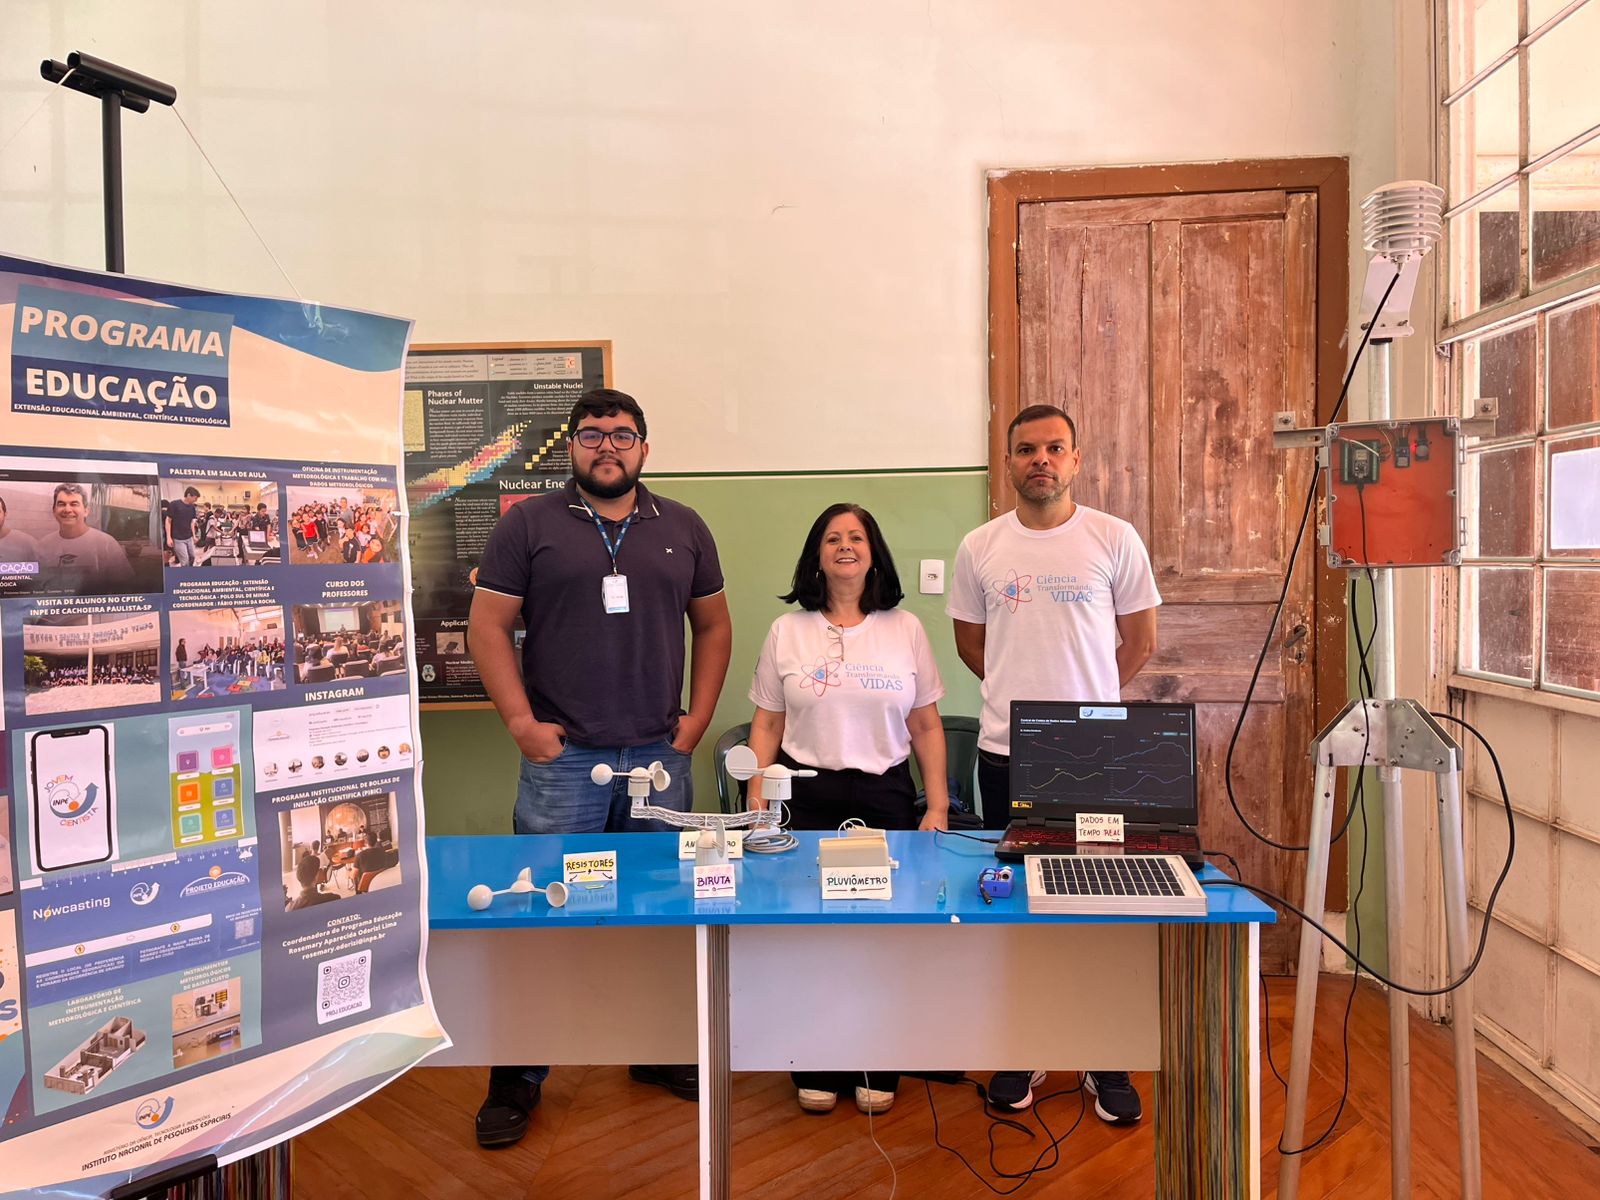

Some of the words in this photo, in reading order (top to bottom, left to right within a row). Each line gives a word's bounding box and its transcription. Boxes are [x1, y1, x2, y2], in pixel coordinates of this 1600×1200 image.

[20, 306, 224, 357] PROGRAMA
[27, 368, 217, 413] EDUCAÇÃO
[14, 404, 50, 412] EXTENSÃO
[52, 406, 100, 416] EDUCACIONAL
[101, 410, 142, 419] AMBIENTAL,
[144, 414, 178, 422] CIENTÍFICA
[185, 416, 227, 425] TECNOLÓGICA
[169, 468, 206, 477] PALESTRA
[219, 470, 237, 478] SALA
[248, 471, 267, 479] AULA
[500, 480, 543, 490] Nuclear
[545, 479, 565, 489] Ene
[0, 561, 34, 574] CAÇÃO
[326, 580, 349, 588] CURSO
[350, 579, 364, 588] DOS
[1036, 575, 1077, 584] Ciência
[322, 590, 368, 598] PROFESSORES
[1051, 591, 1093, 602] VIDAS
[107, 604, 152, 612] PAULISTA-SP
[845, 663, 884, 672] Ciência
[860, 678, 903, 691] VIDAS
[305, 687, 364, 702] INSTAGRAM
[44, 774, 74, 793] JOVEM
[272, 793, 310, 804] PROGRAMA
[311, 784, 358, 797] INSTITUCIONAL
[369, 778, 391, 786] BOLSAS
[52, 797, 69, 807] INPE
[293, 798, 326, 808] INICIAÇÃO
[60, 805, 99, 826] CIENTISTA
[1080, 816, 1103, 824] DADOS
[1078, 828, 1100, 836] TEMPO
[565, 858, 614, 871] RESISTORES
[186, 883, 212, 894] PROJETO
[214, 876, 246, 888] EDUCAÇÃO
[696, 876, 730, 886] BIRUTA
[826, 874, 889, 886] PLUVIÔMETRO
[33, 897, 111, 920] Nowcasting
[327, 913, 362, 928] CONTATO:
[282, 928, 330, 947] Coordenadora
[341, 920, 372, 932] Programa
[374, 911, 402, 922] Educação
[288, 941, 323, 954] Rosemary
[324, 932, 357, 946] Aparecida
[382, 921, 397, 929] Lima
[66, 995, 124, 1014] INSTRUMENTAÇÃO
[67, 991, 112, 1006] LABORATÓRIO
[48, 1008, 102, 1026] METEOROLÓGICA
[108, 998, 142, 1010] CIENTÍFICA
[82, 1154, 117, 1171] INSTITUTO
[118, 1140, 152, 1158] NACIONAL
[153, 1135, 162, 1145] DE
[163, 1124, 199, 1142] PESQUISAS
[200, 1113, 232, 1128] ESPACIAIS
